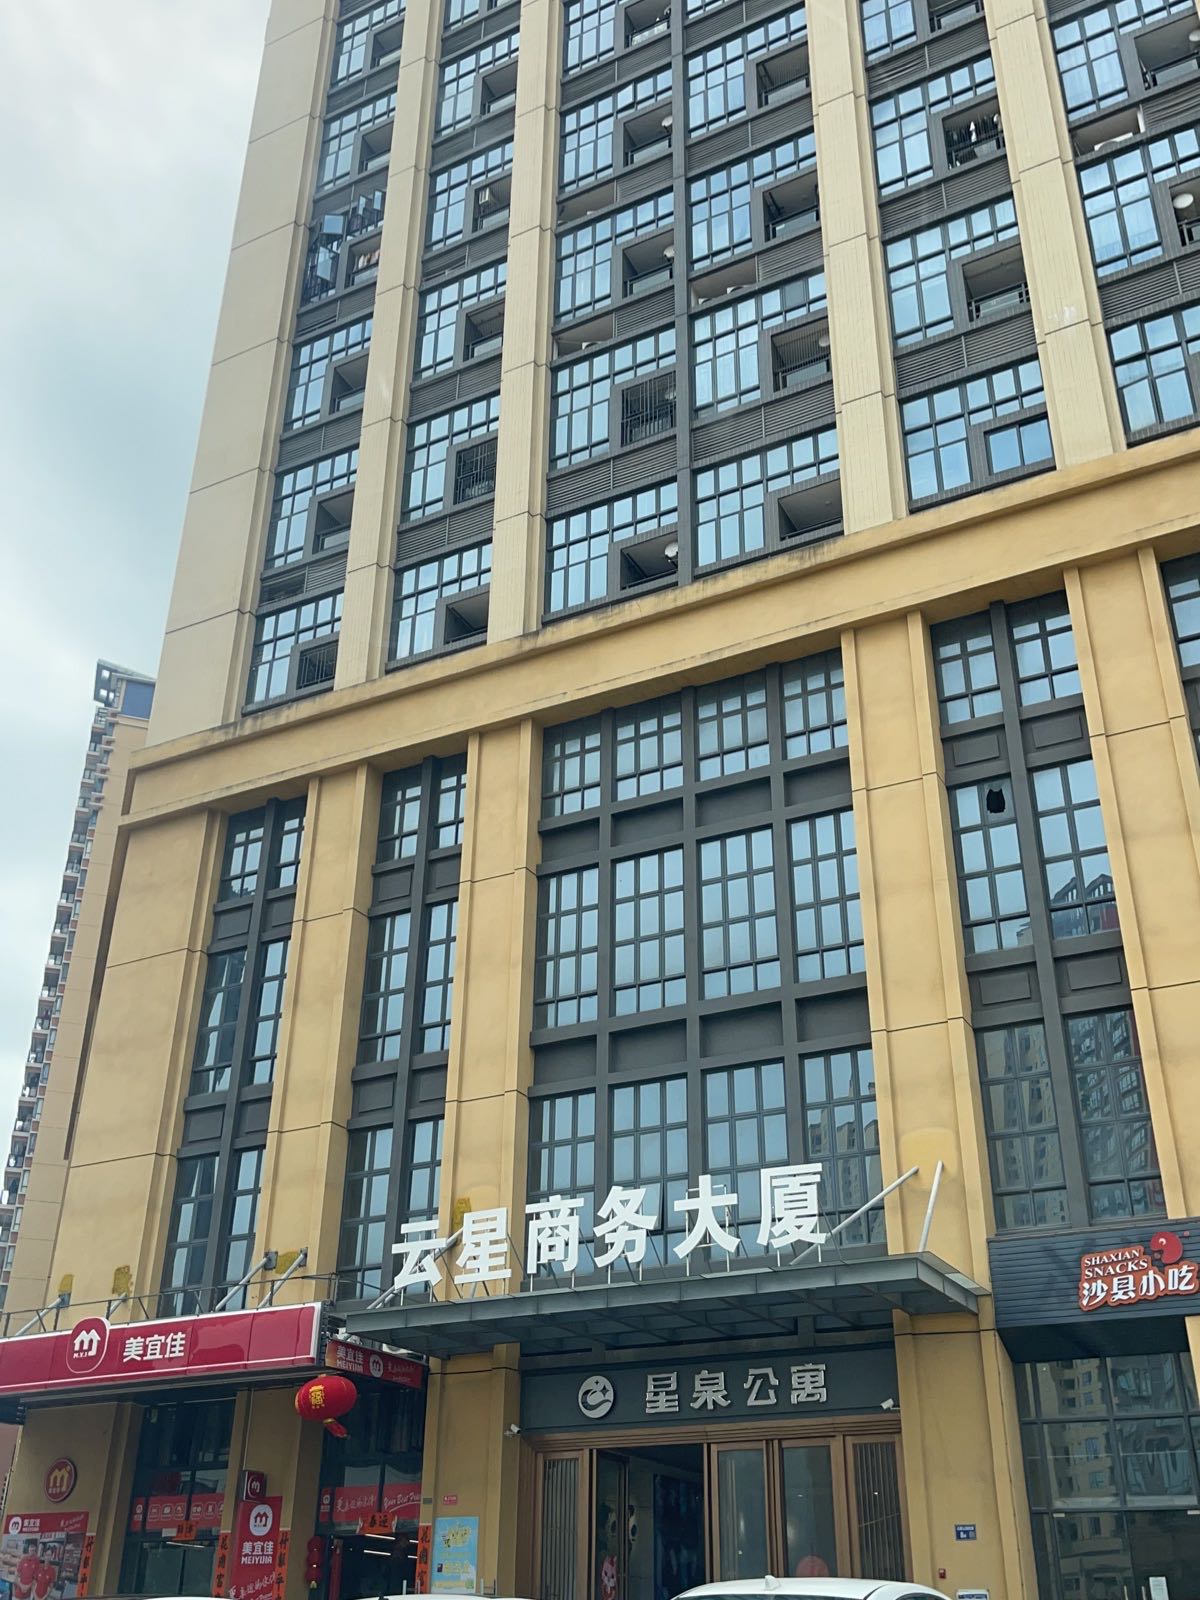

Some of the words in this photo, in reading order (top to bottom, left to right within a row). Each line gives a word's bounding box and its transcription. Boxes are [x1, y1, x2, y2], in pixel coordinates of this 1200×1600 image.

[392, 1163, 826, 1290] 云星商务大厦
[1084, 1248, 1140, 1267] SHAXIAN
[1084, 1259, 1148, 1279] SNACKS
[1082, 1265, 1195, 1306] 沙县小吃
[123, 1331, 186, 1362] 美宜佳
[336, 1345, 364, 1364] 美宜佳
[645, 1363, 826, 1414] 星泉公寓
[241, 1541, 274, 1555] 美宜佳
